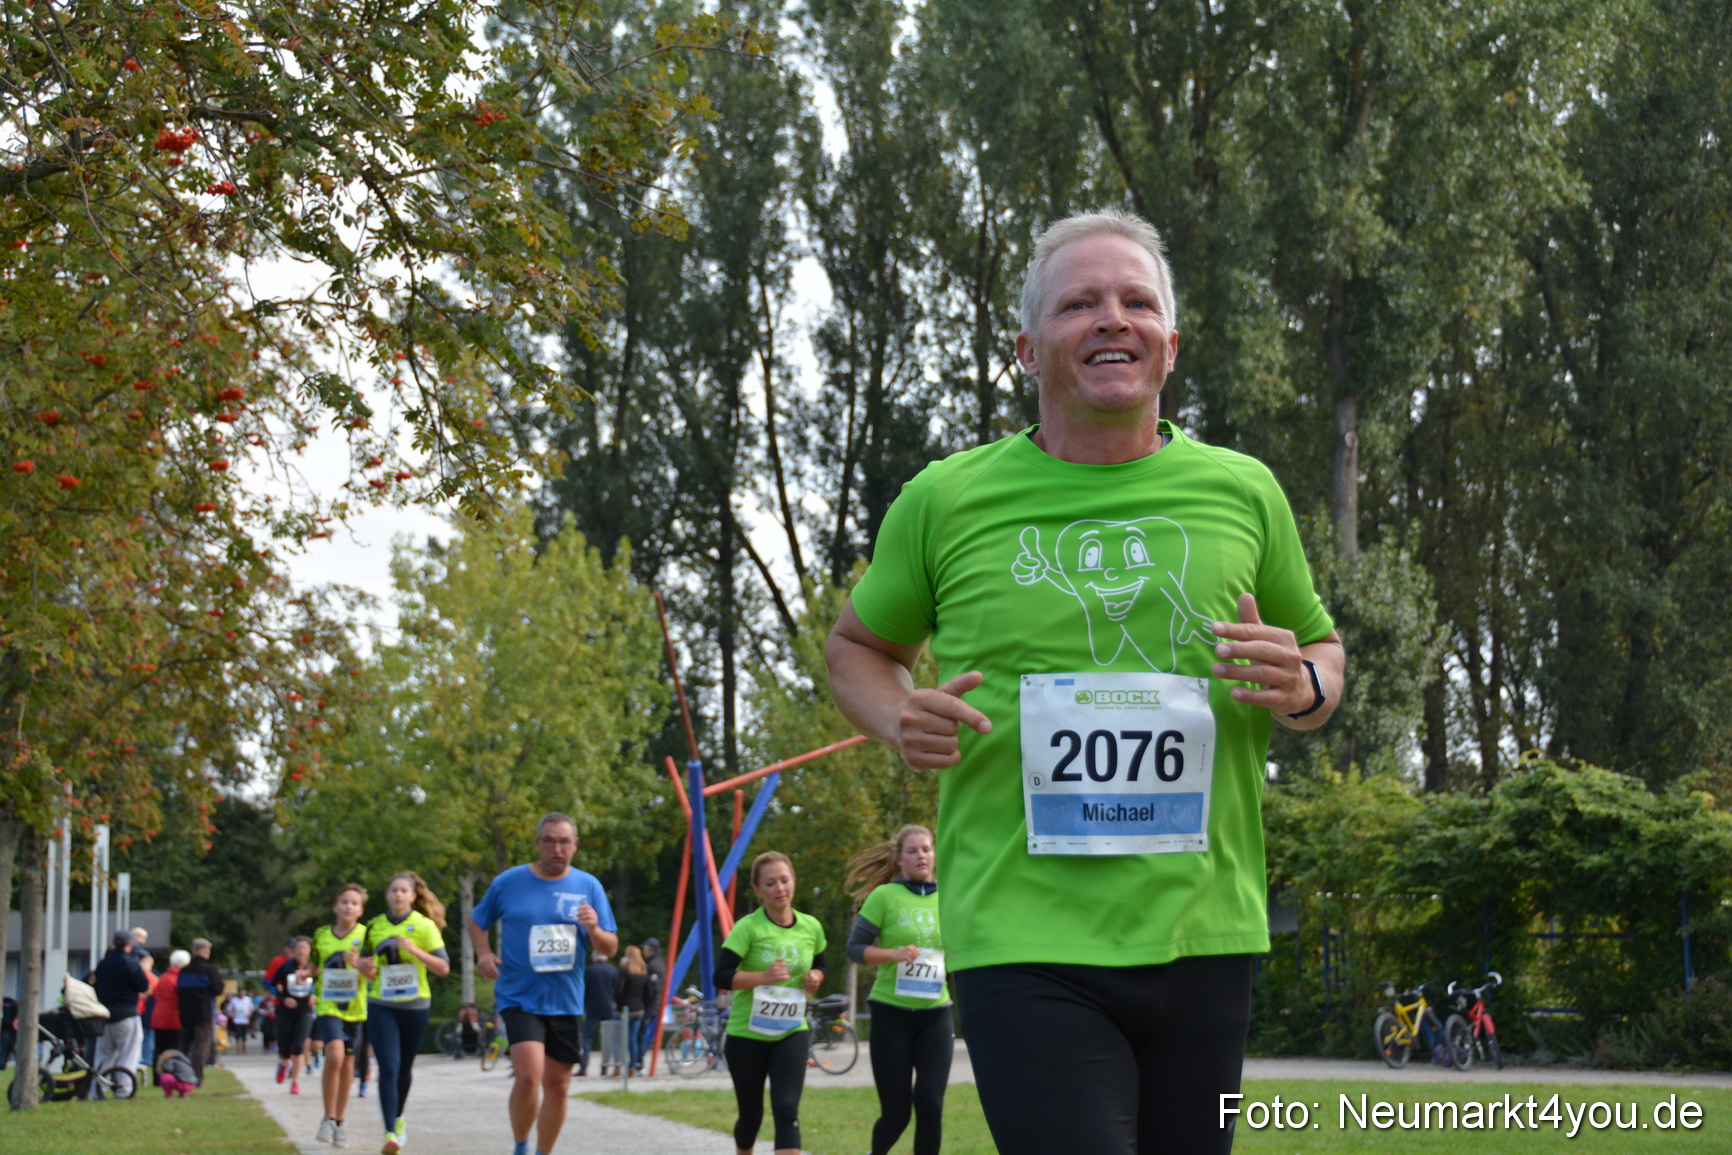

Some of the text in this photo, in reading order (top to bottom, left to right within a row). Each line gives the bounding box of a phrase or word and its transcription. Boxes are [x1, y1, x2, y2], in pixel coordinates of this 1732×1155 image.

[1094, 690, 1161, 705] BOCK
[1050, 729, 1185, 783] 2076
[1034, 776, 1041, 786] D
[1082, 803, 1154, 822] Michael
[537, 938, 570, 953] 2339
[760, 1001, 797, 1017] 2770
